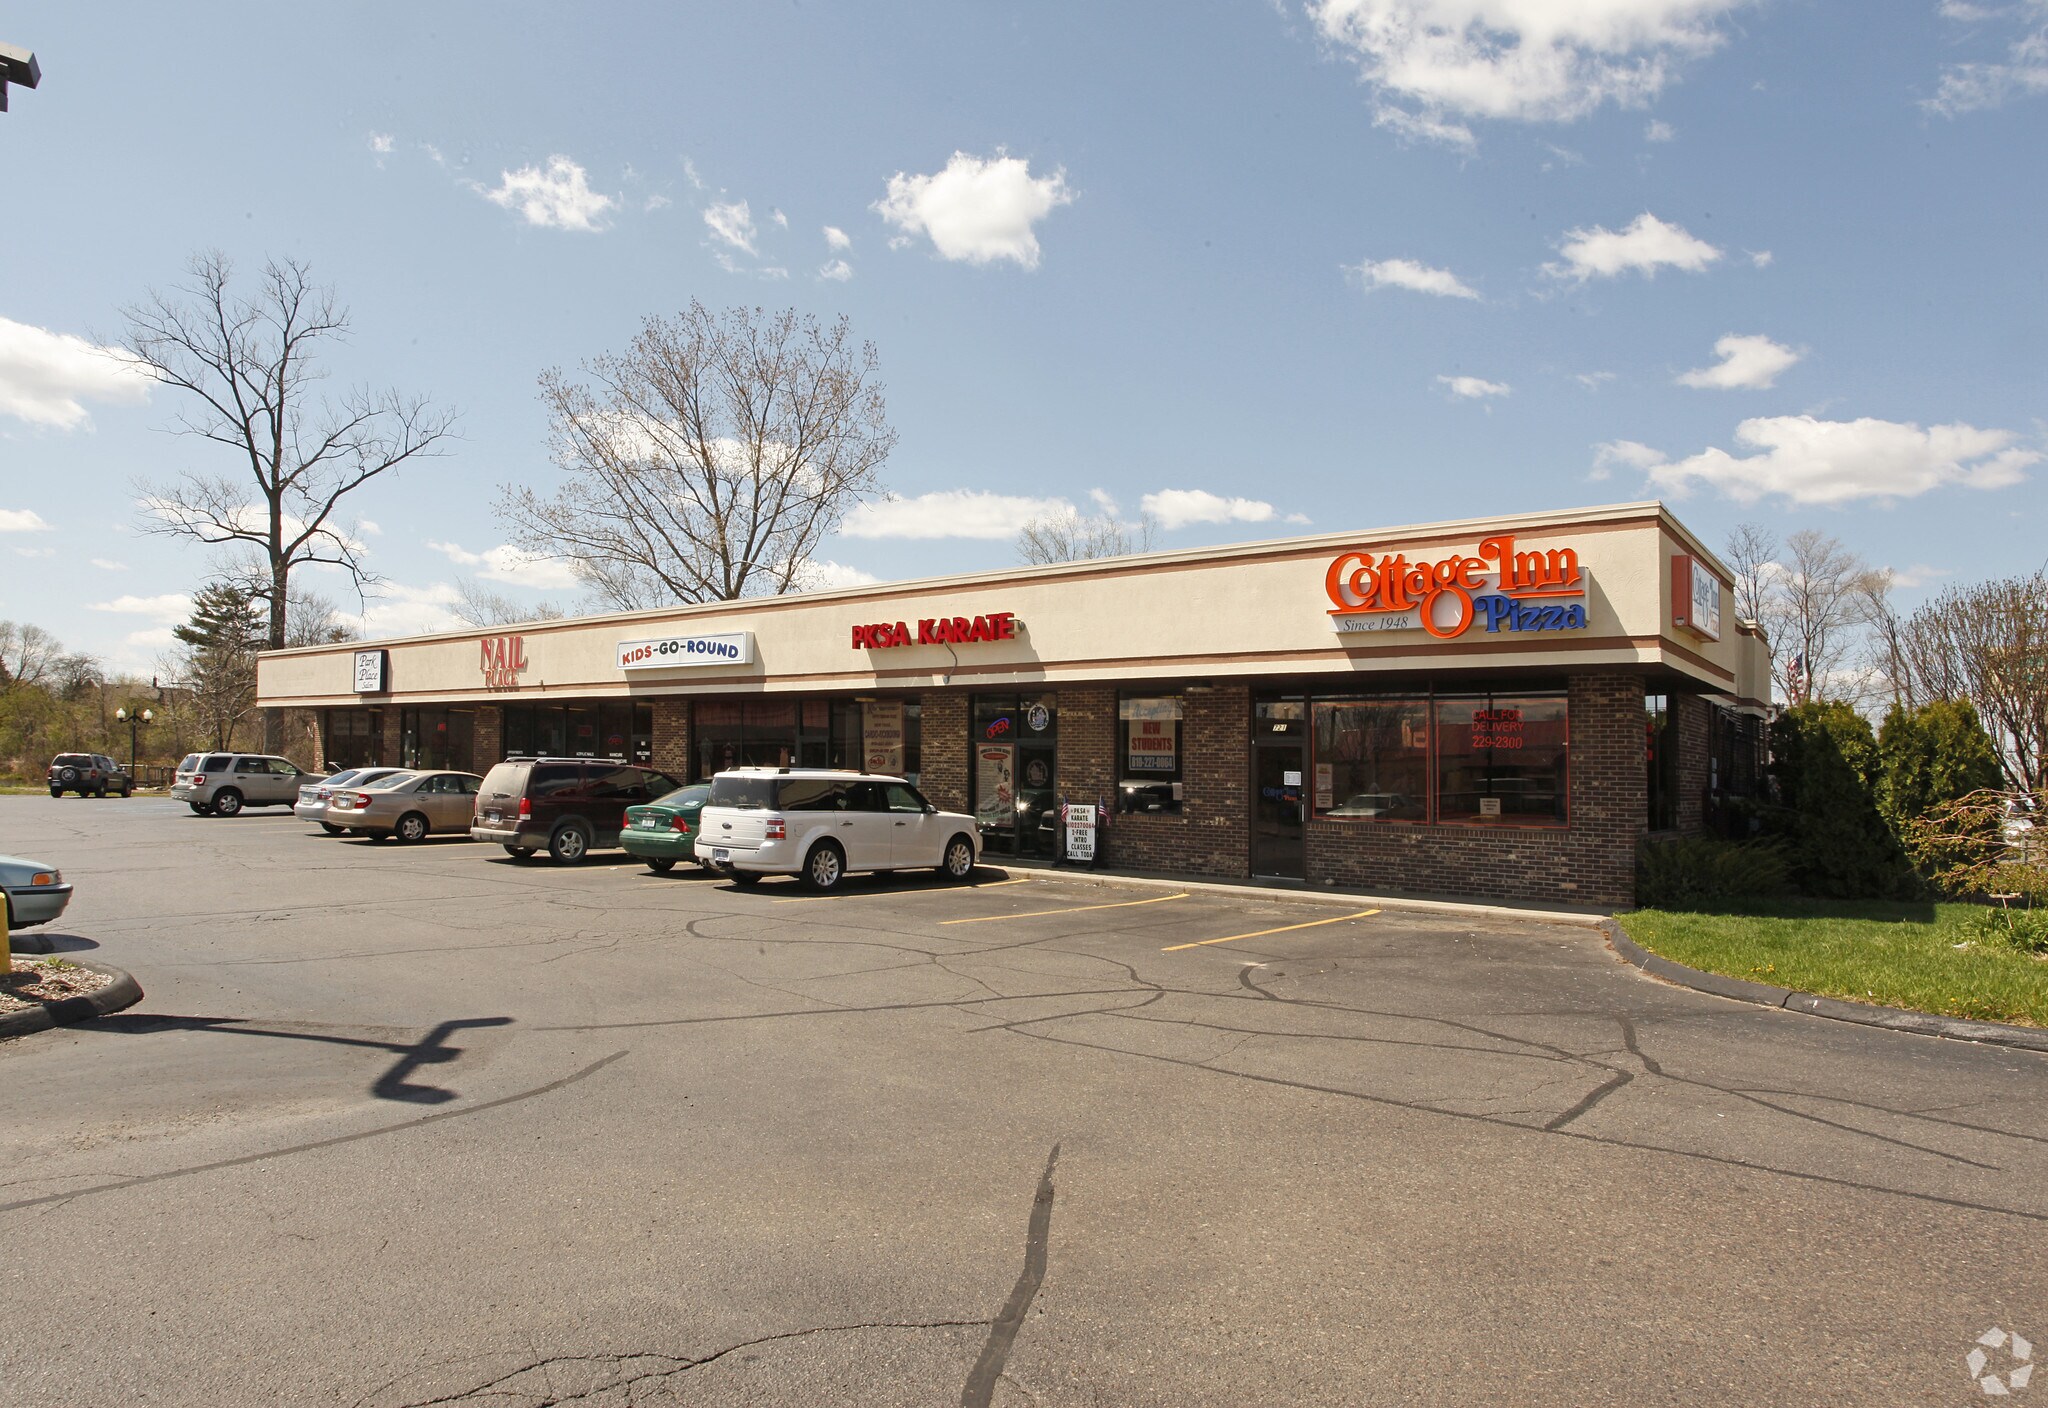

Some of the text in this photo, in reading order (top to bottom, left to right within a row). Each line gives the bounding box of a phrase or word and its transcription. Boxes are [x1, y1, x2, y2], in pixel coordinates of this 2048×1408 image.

[1325, 535, 1581, 639] Cottage Inn
[1474, 595, 1587, 633] Pizza
[852, 612, 1015, 650] PKSA KARATE
[1343, 617, 1408, 632] Since 1948
[480, 636, 525, 670] NAIL
[622, 640, 739, 665] KIDS-GO-ROUND
[359, 654, 377, 669] Park
[358, 668, 378, 681] Place
[485, 668, 518, 687] PLACE
[1471, 709, 1524, 720] CALL FOR
[986, 719, 1010, 739] OPEN
[1142, 721, 1161, 735] NEW
[1471, 720, 1525, 732] DELIVERY
[1131, 737, 1173, 751] STUDENTS
[1472, 735, 1523, 749] 229-2300
